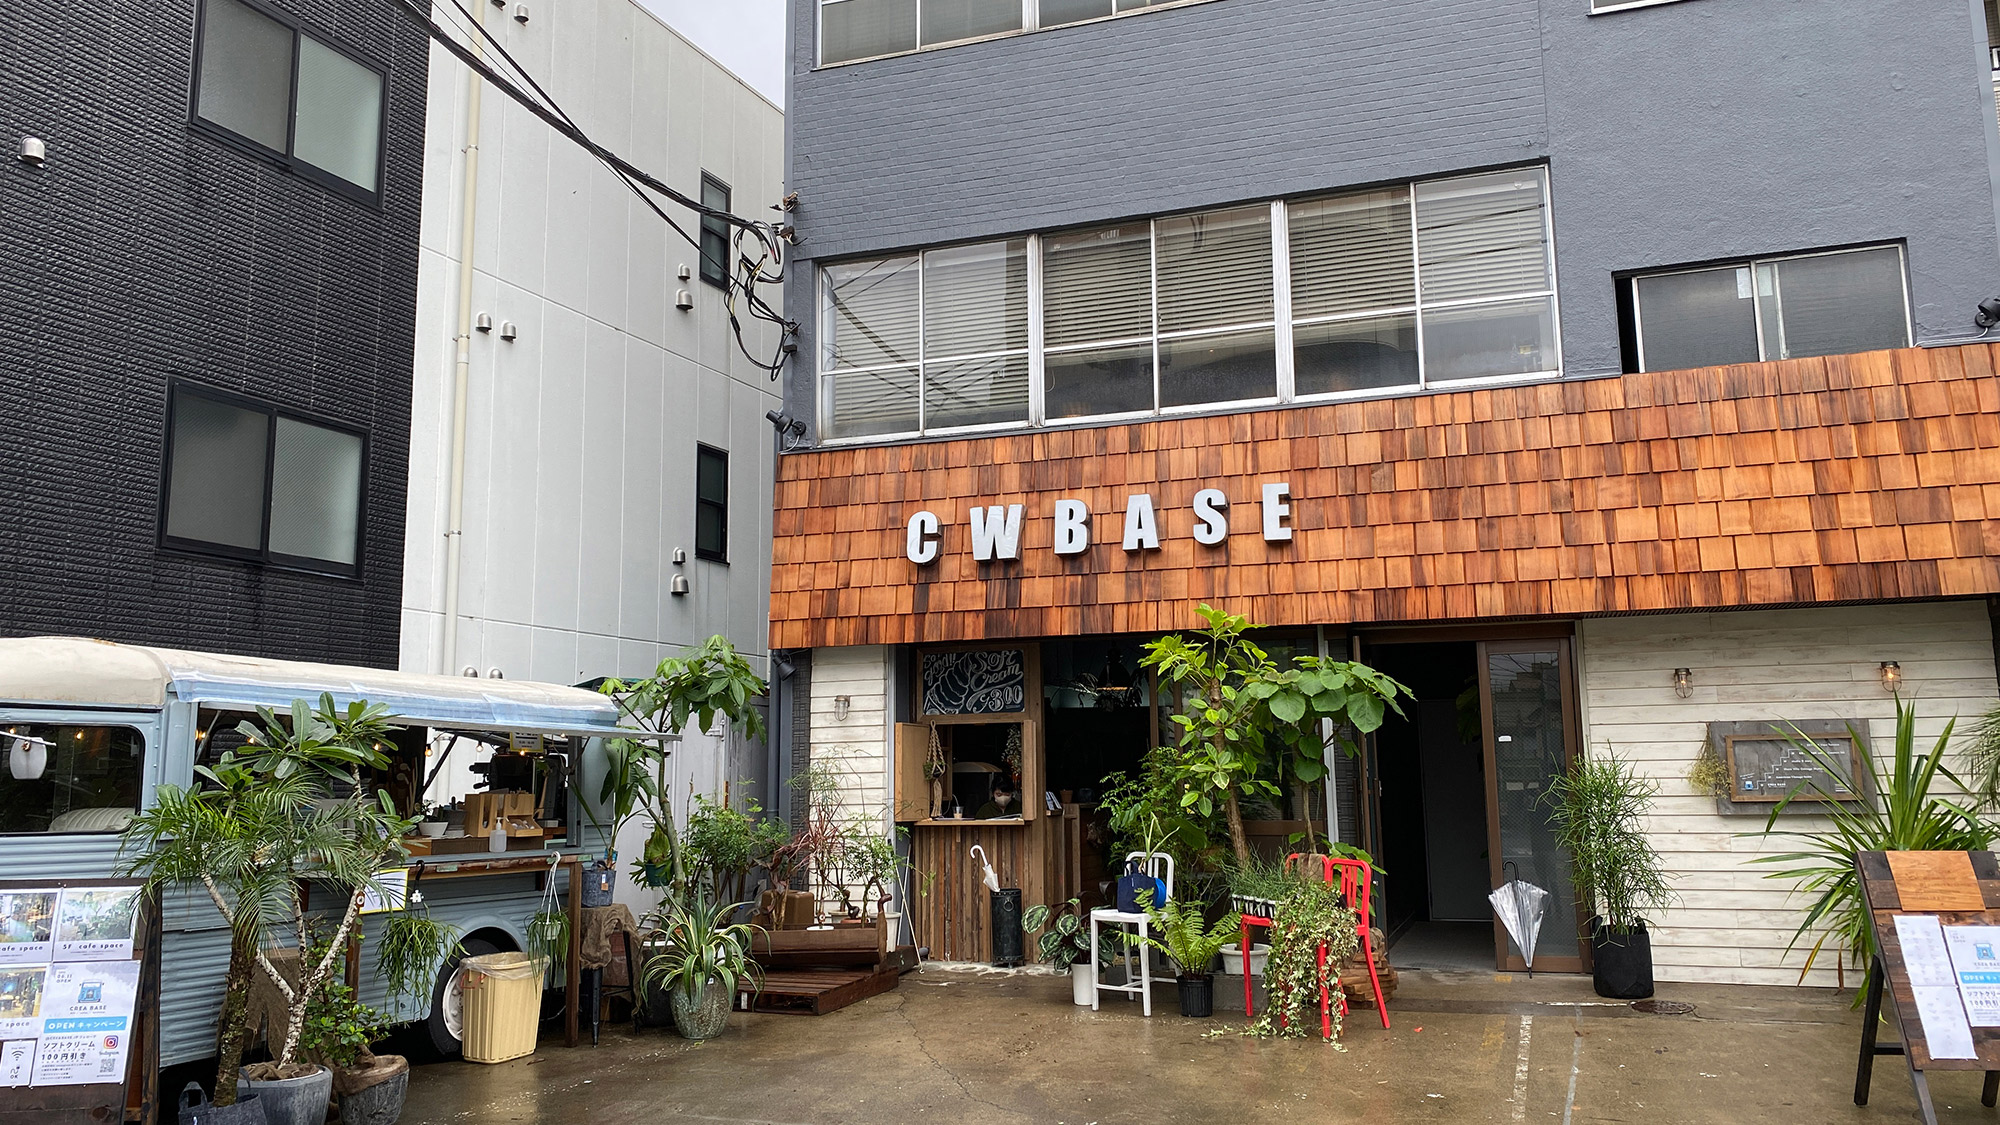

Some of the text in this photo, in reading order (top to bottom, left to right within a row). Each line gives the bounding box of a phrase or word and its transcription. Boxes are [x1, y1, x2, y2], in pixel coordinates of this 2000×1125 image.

[906, 482, 1294, 565] CWBASE
[971, 650, 1017, 674] Soft
[970, 663, 1021, 691] Cream
[48, 1020, 124, 1030] OPEN キャンペーン
[44, 1041, 95, 1049] ソフトクリーム
[41, 1052, 86, 1060] 100円引き
